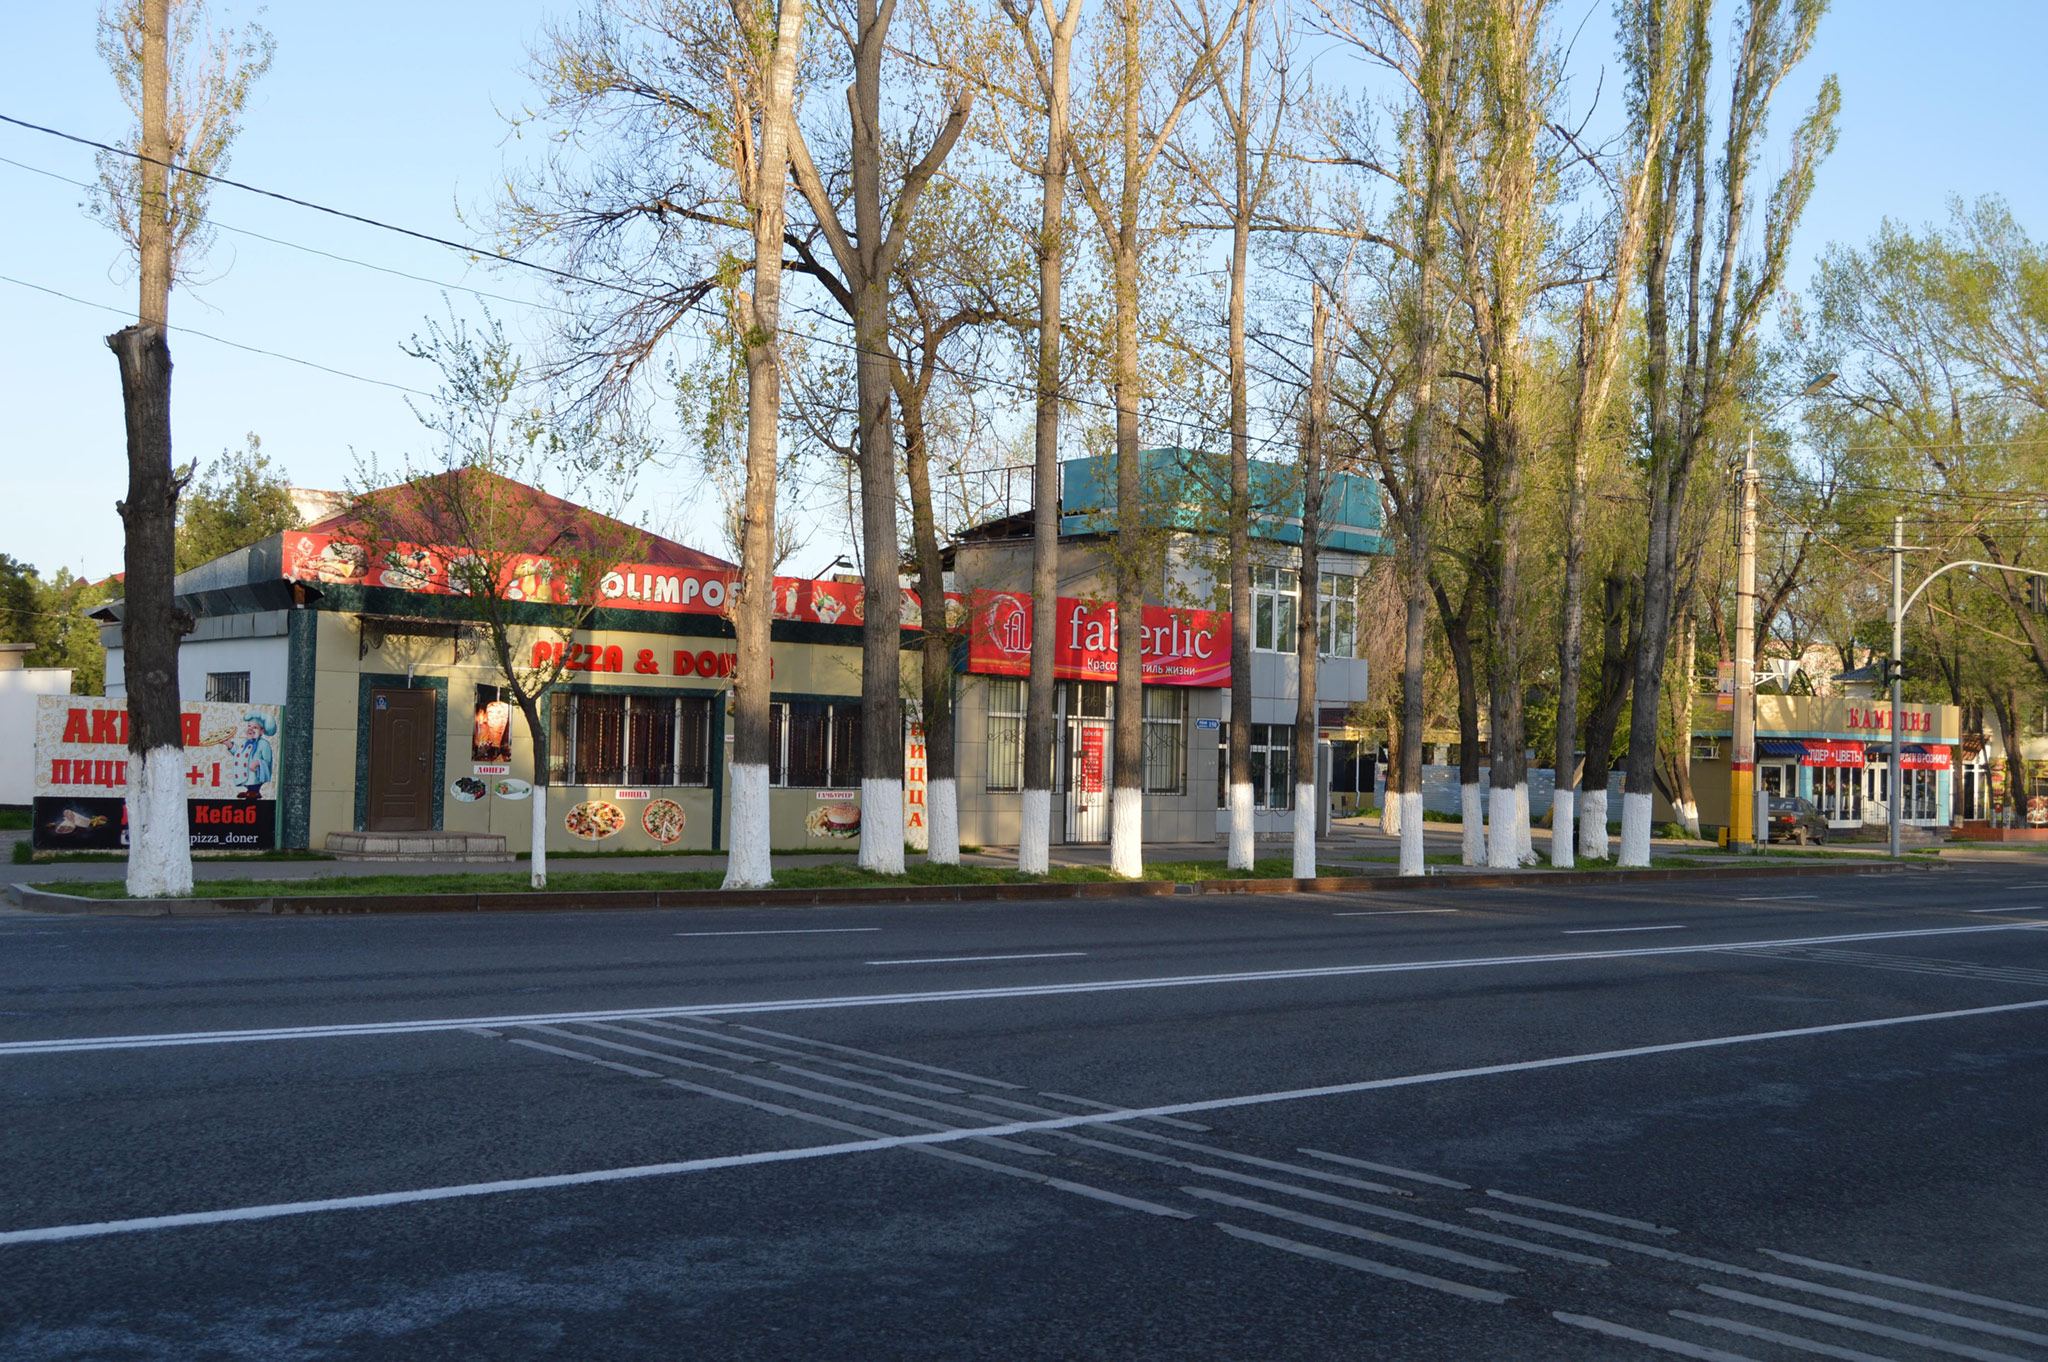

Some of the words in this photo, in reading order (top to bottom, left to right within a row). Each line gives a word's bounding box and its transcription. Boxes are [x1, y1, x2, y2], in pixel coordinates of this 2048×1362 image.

[532, 641, 623, 673] PIZZA
[633, 648, 660, 675] &
[673, 650, 774, 680] DON
[1087, 657, 1119, 673] Красо
[1141, 664, 1164, 674] тиль
[1165, 665, 1196, 676] жизни
[62, 708, 202, 747] АКЯ
[1836, 750, 1863, 764] ЦВЕТЫ
[1922, 754, 1948, 765] РОЗНИЦУ
[51, 759, 128, 788] ПИЦЦ
[908, 721, 925, 827] ПИЦЦА
[195, 805, 257, 824] Кебаб
